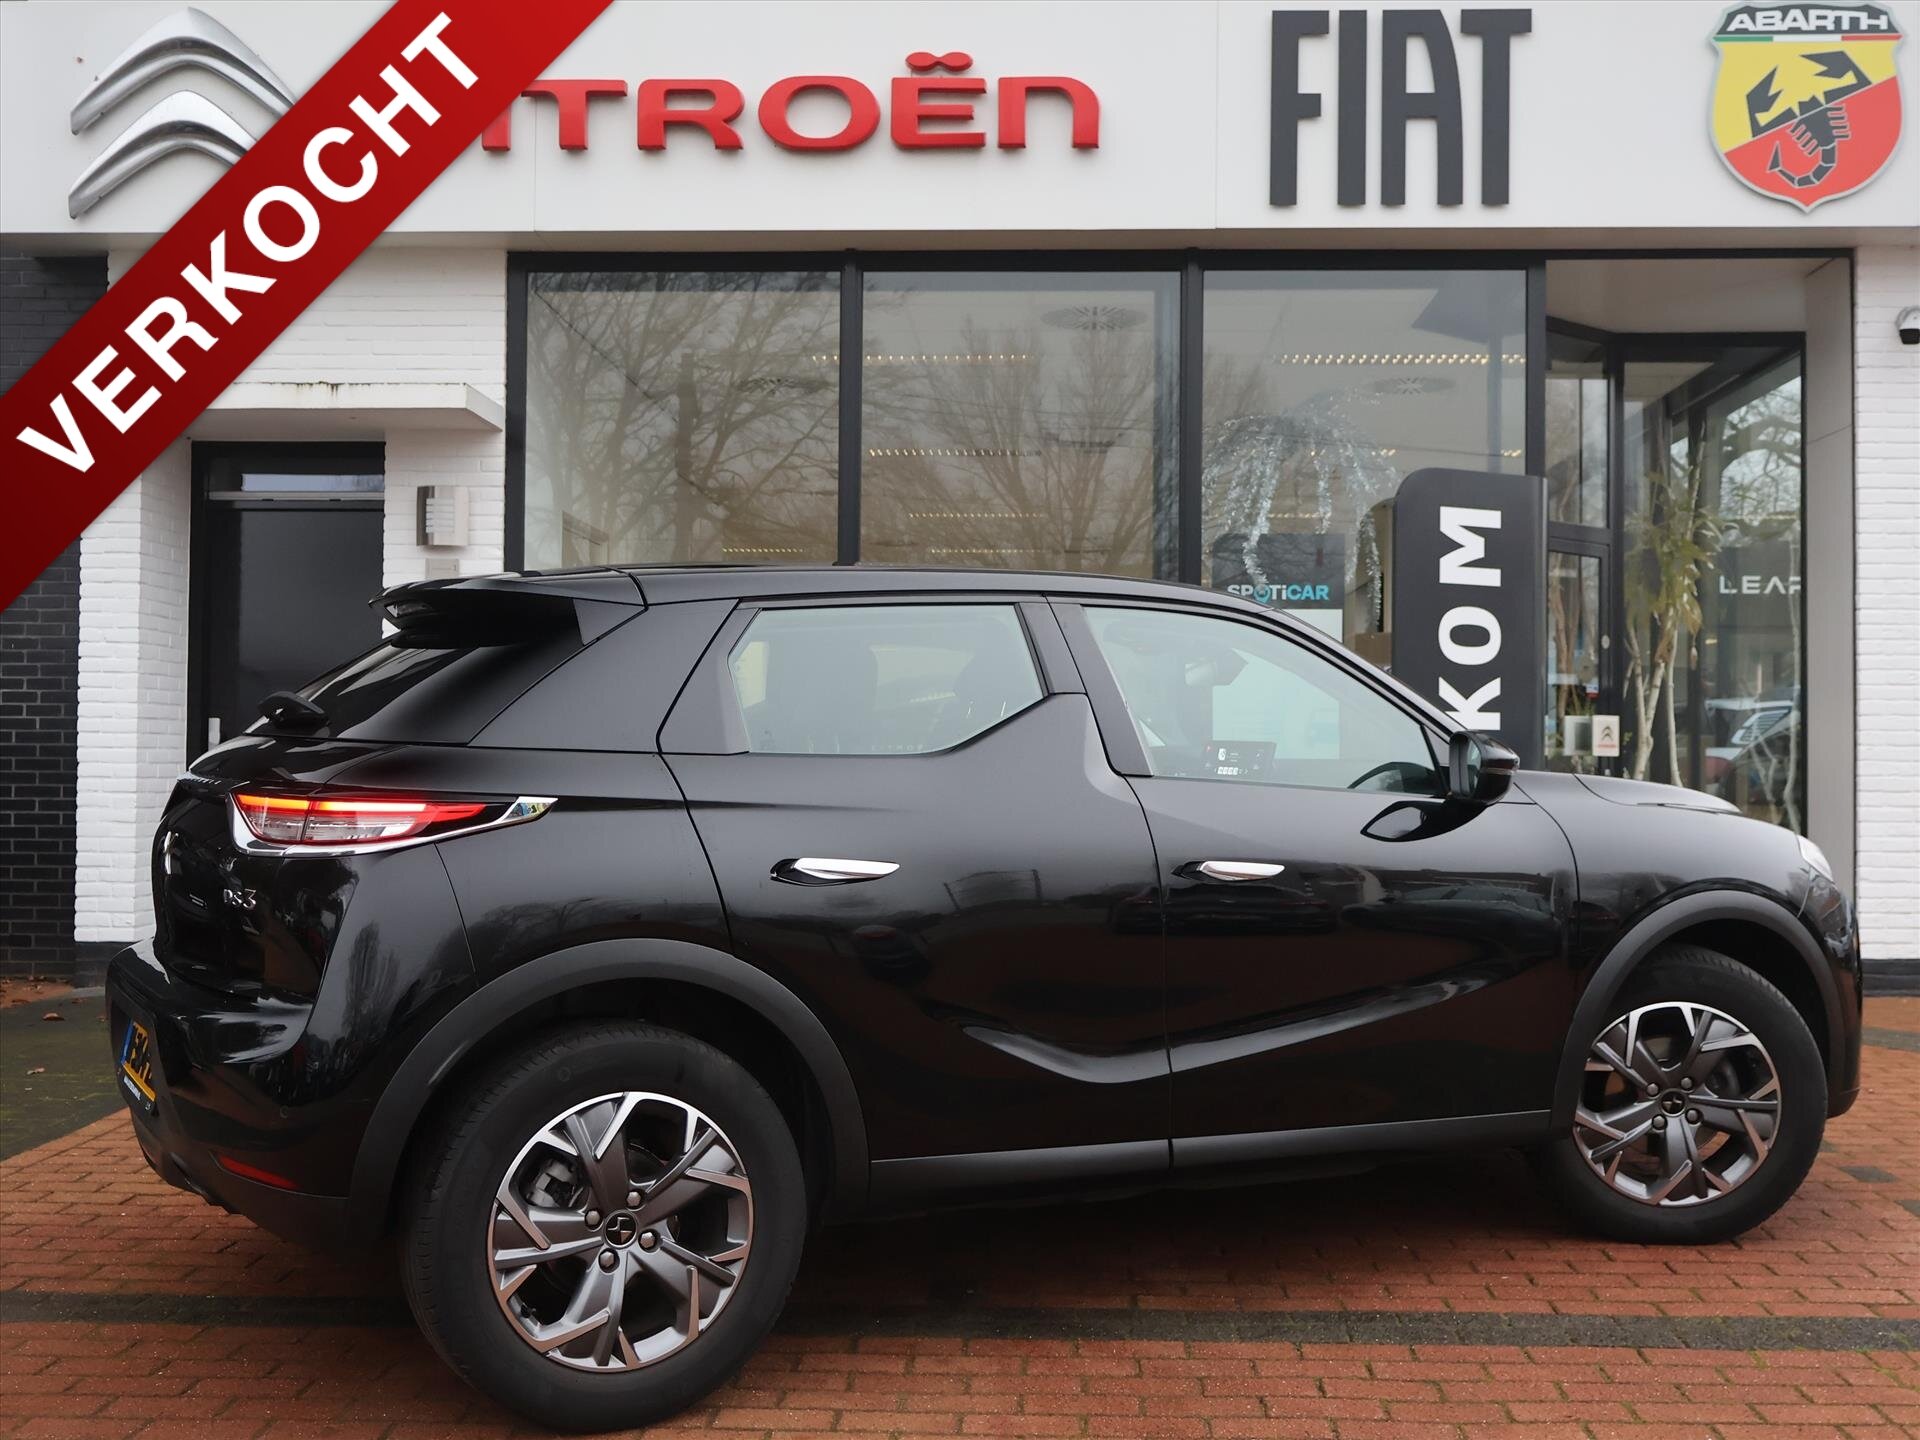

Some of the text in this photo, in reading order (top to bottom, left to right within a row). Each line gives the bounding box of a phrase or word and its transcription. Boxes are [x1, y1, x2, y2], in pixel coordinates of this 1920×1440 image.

[1269, 8, 1532, 207] FIAT
[1726, 8, 1888, 32] ABARTH
[1438, 505, 1501, 730] KOM
